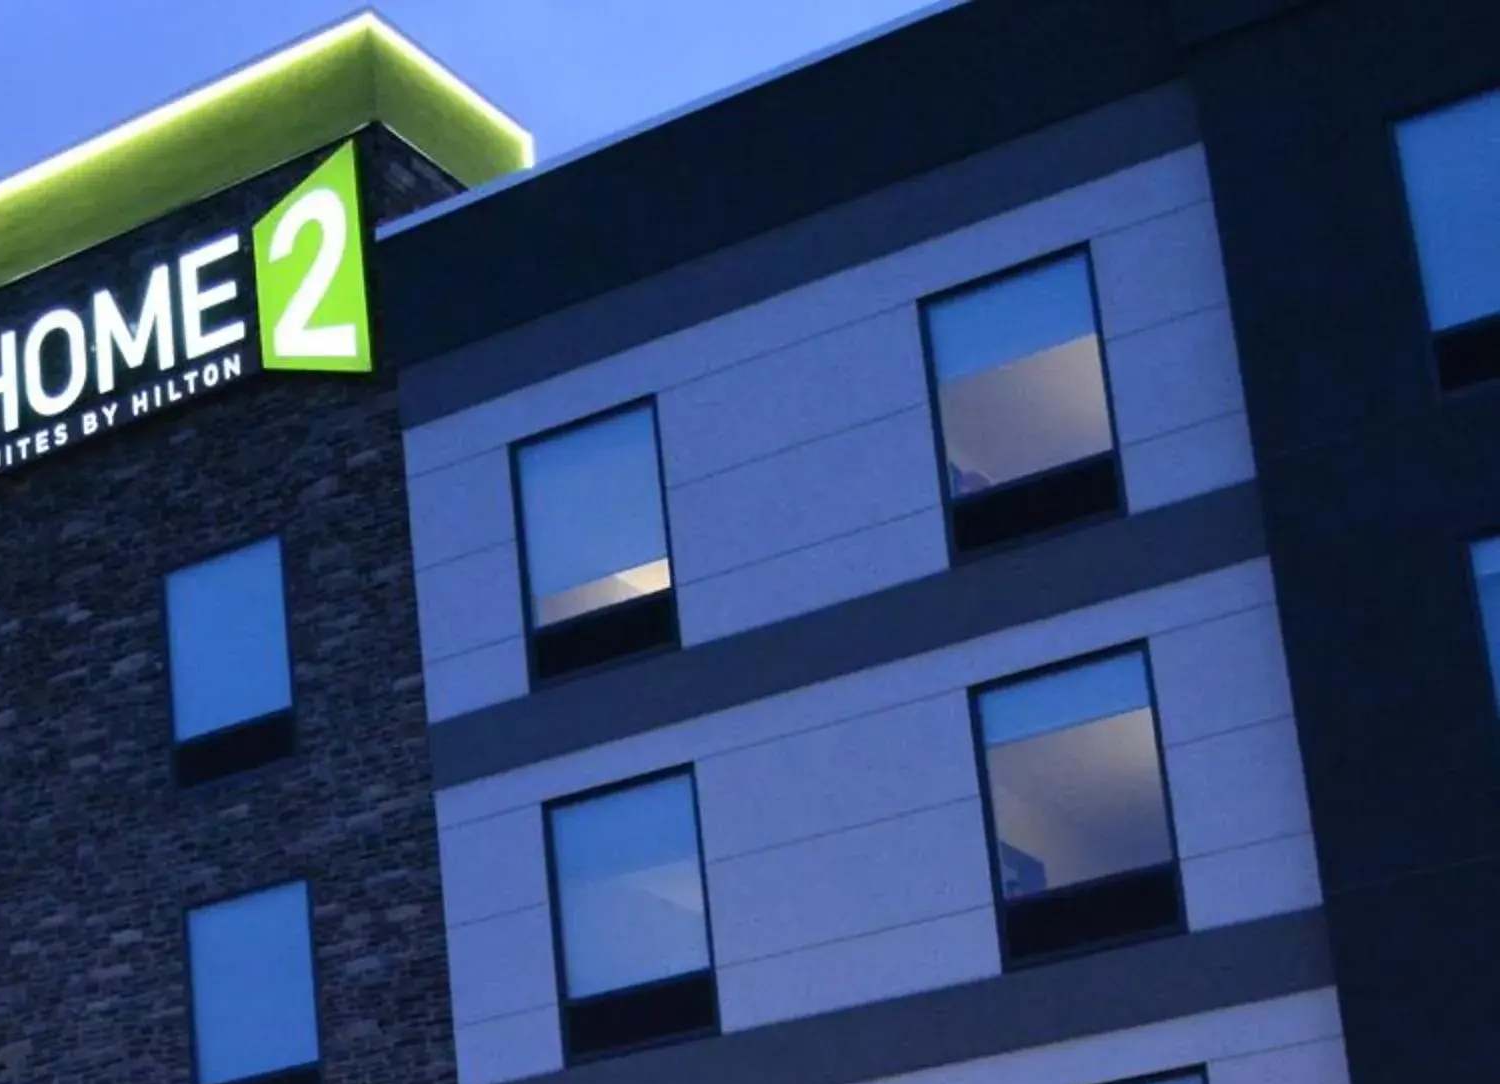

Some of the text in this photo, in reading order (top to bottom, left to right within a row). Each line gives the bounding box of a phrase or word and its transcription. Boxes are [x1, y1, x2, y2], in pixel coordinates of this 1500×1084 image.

[267, 186, 358, 358] 2
[81, 402, 118, 435] BY
[131, 353, 242, 417] HILTON
